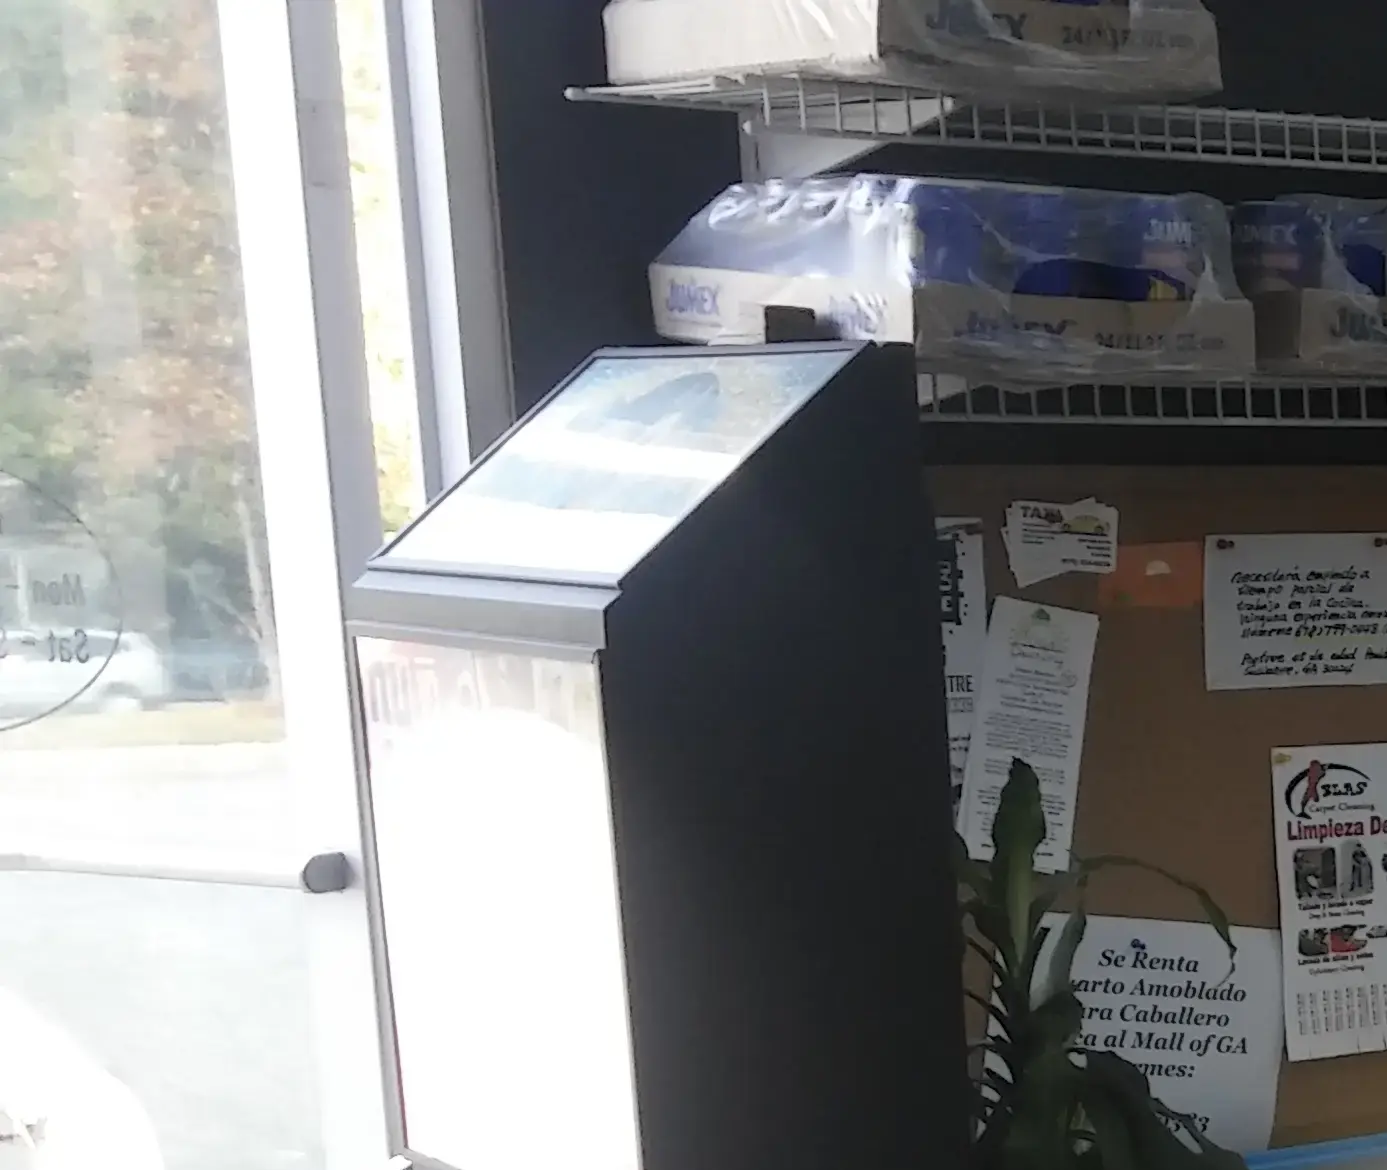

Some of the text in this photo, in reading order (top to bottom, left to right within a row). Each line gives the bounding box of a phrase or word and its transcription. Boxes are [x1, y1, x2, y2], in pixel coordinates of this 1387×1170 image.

[1287, 818, 1364, 843] Limpieza
[1098, 949, 1200, 973] Se Renta
[1129, 978, 1248, 1003] Amoblado
[1119, 1004, 1231, 1028] Caballero
[1103, 1030, 1127, 1049] al
[1130, 1031, 1184, 1052] Mall
[1188, 1034, 1216, 1057] of
[1216, 1035, 1249, 1055] GA
